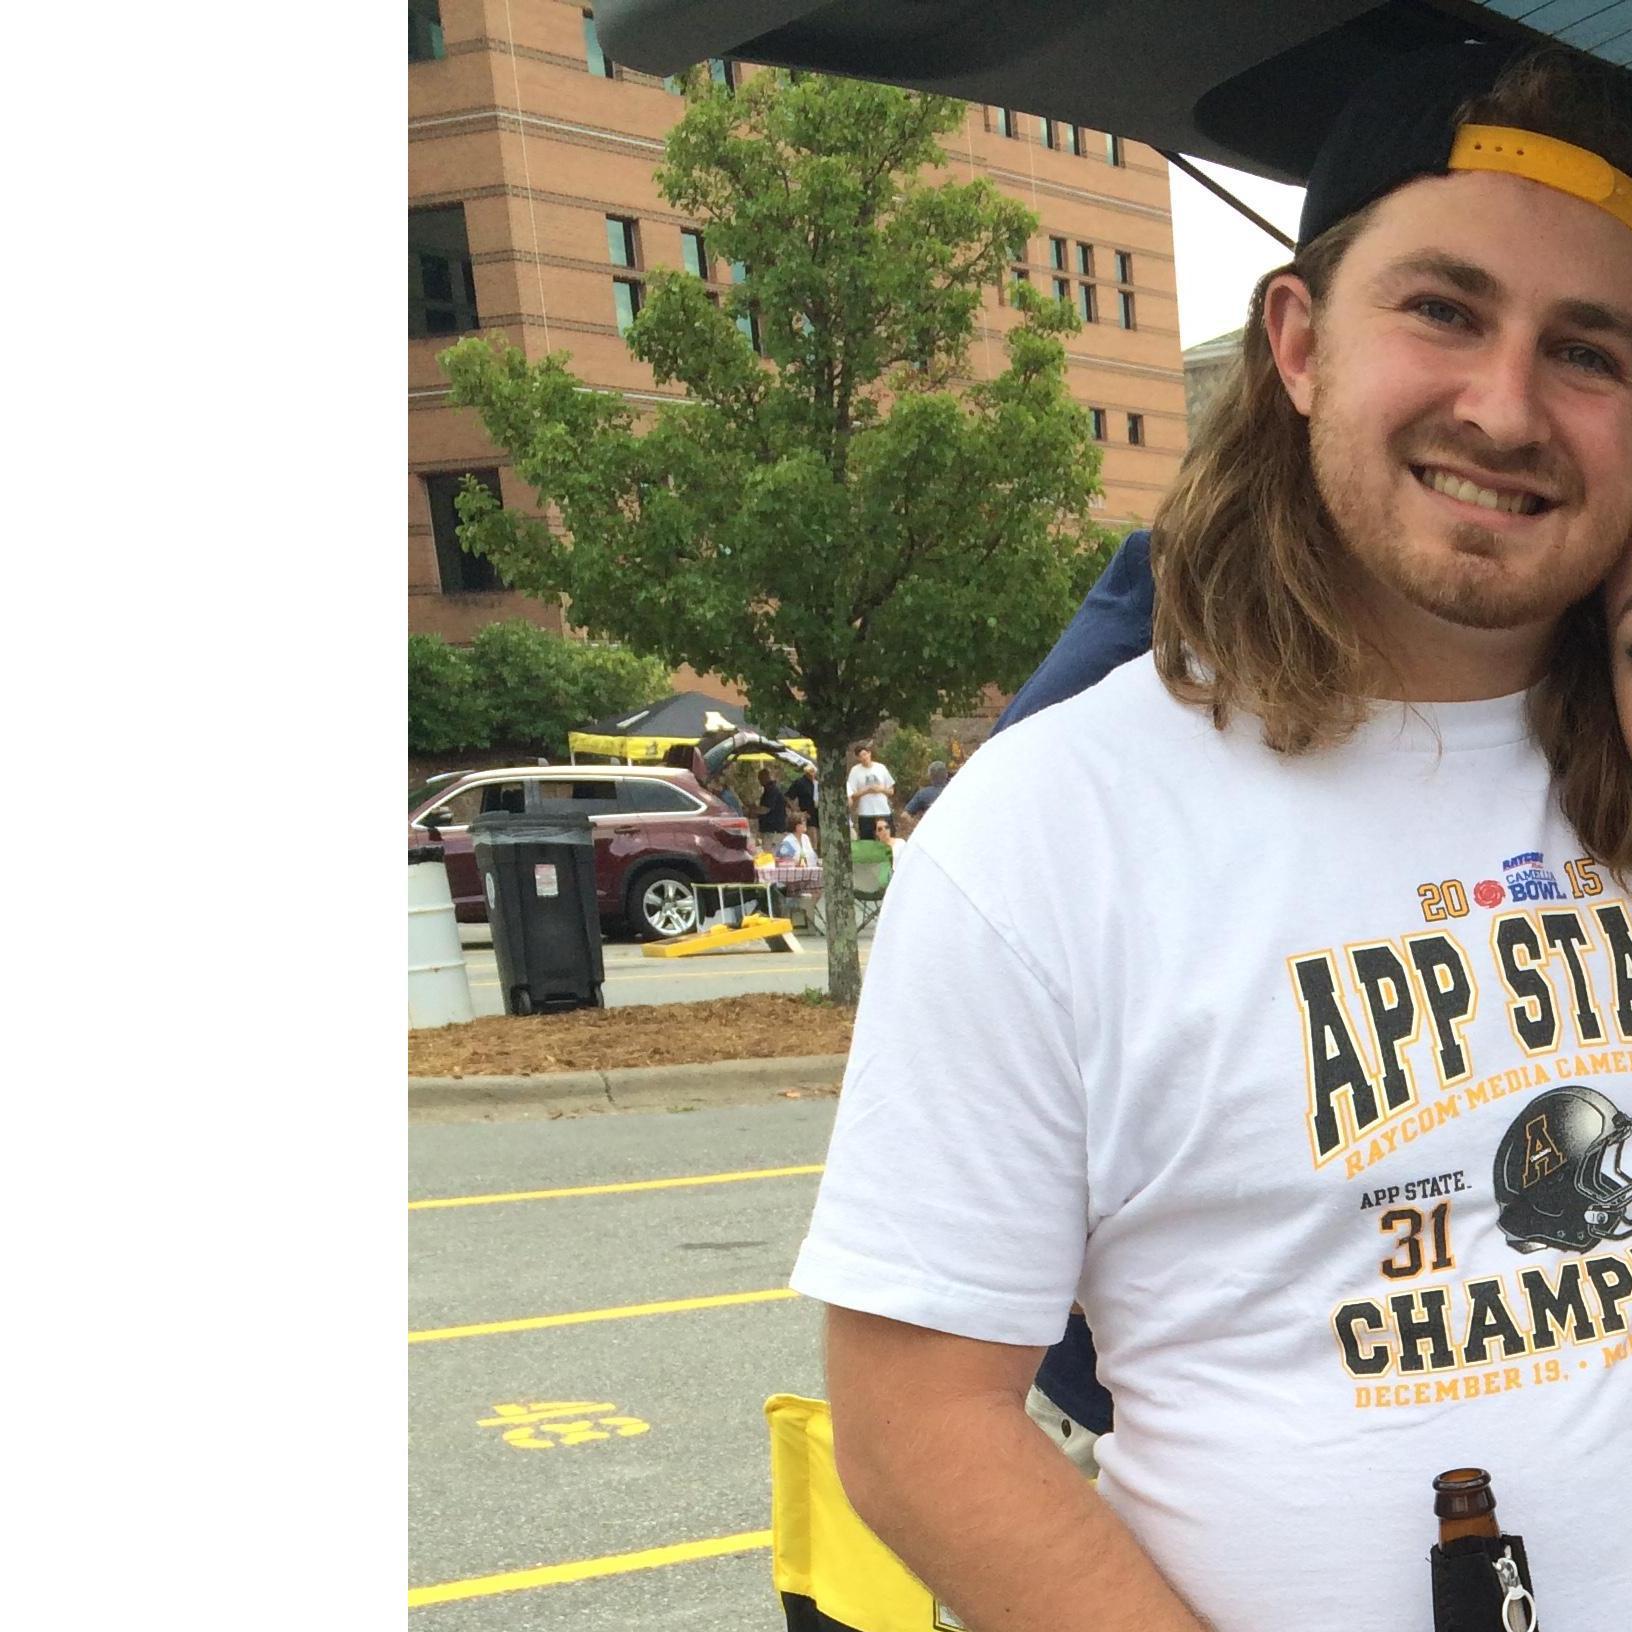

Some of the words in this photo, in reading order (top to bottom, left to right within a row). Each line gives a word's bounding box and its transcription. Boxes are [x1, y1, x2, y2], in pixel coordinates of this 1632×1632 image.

[1418, 879, 1469, 922] 20
[1564, 858, 1603, 899] 15
[1505, 869, 1556, 884] CAMELLIA
[1507, 881, 1567, 902] BOWL
[1287, 929, 1478, 1170] APP
[1344, 1090, 1461, 1181] RAYCOM
[1465, 1060, 1552, 1110] MEDIA
[1360, 1184, 1402, 1210] APP
[1378, 1200, 1456, 1282] 31
[1354, 1364, 1523, 1409] DECEMBER
